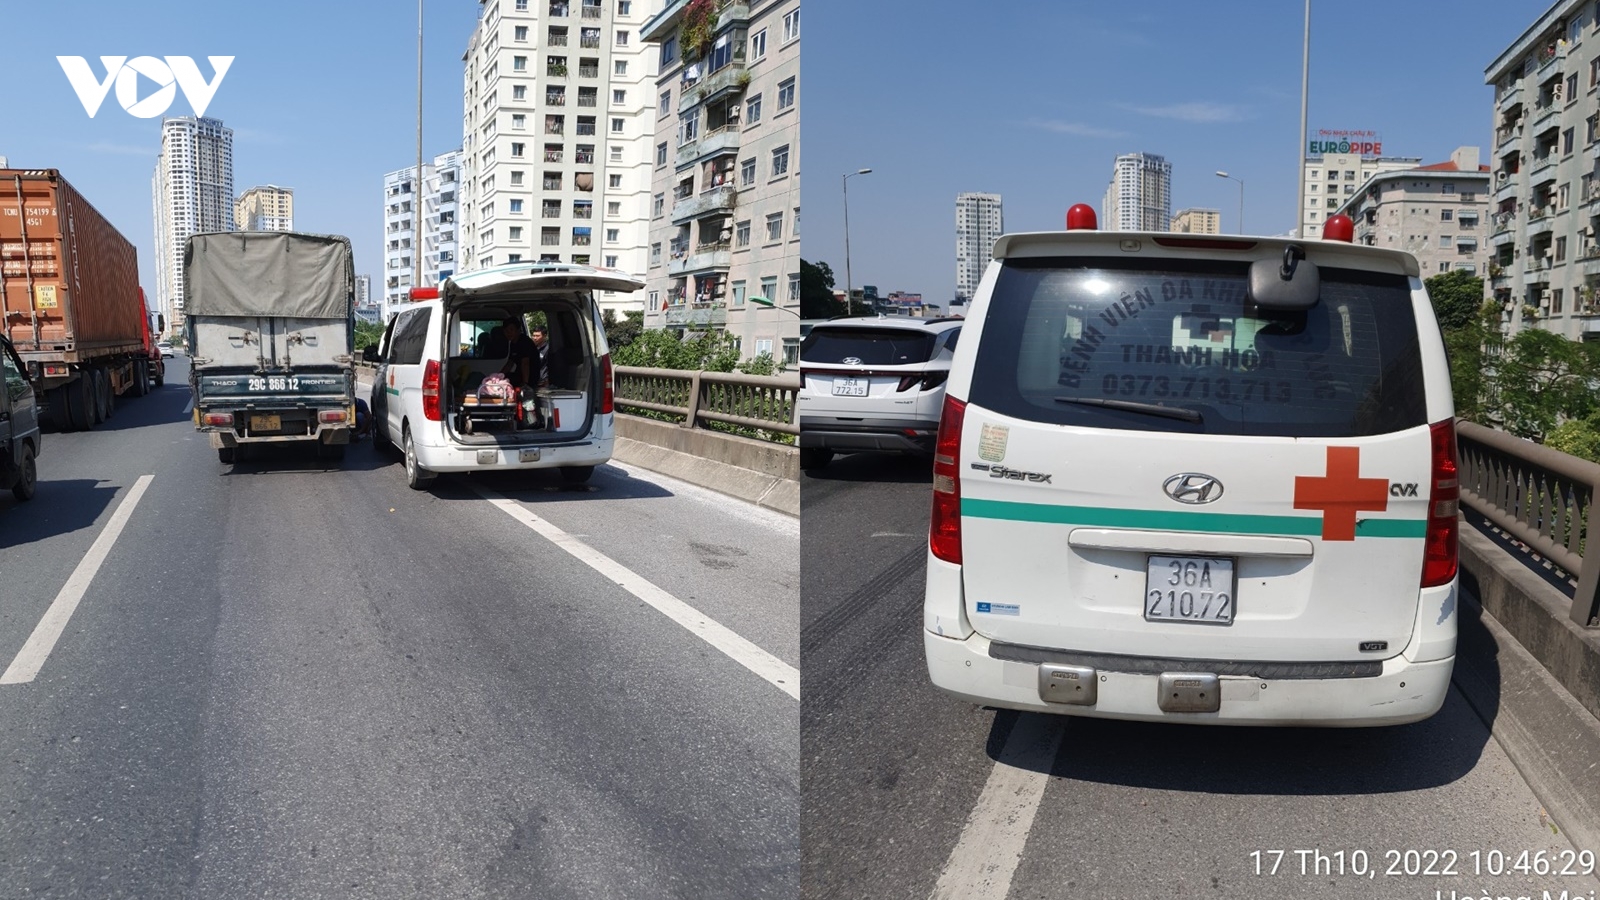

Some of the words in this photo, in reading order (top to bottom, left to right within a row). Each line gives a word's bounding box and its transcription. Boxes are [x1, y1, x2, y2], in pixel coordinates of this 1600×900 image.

[26, 208, 50, 216] 754199
[26, 218, 42, 226] 45G1
[1057, 325, 1106, 389] BỆNH
[1099, 287, 1155, 327] VIỆN
[1161, 279, 1194, 300] ĐA
[1121, 344, 1212, 366] THANH
[248, 379, 266, 391] 29C
[268, 378, 286, 391] 866
[288, 378, 299, 390] 12
[842, 378, 858, 387] 36A
[1102, 373, 1291, 403] 0373.713.713
[989, 464, 1052, 485] Starex
[1390, 483, 1418, 498] CVX
[1168, 560, 1211, 588] 36A
[1148, 589, 1230, 619] 210.72
